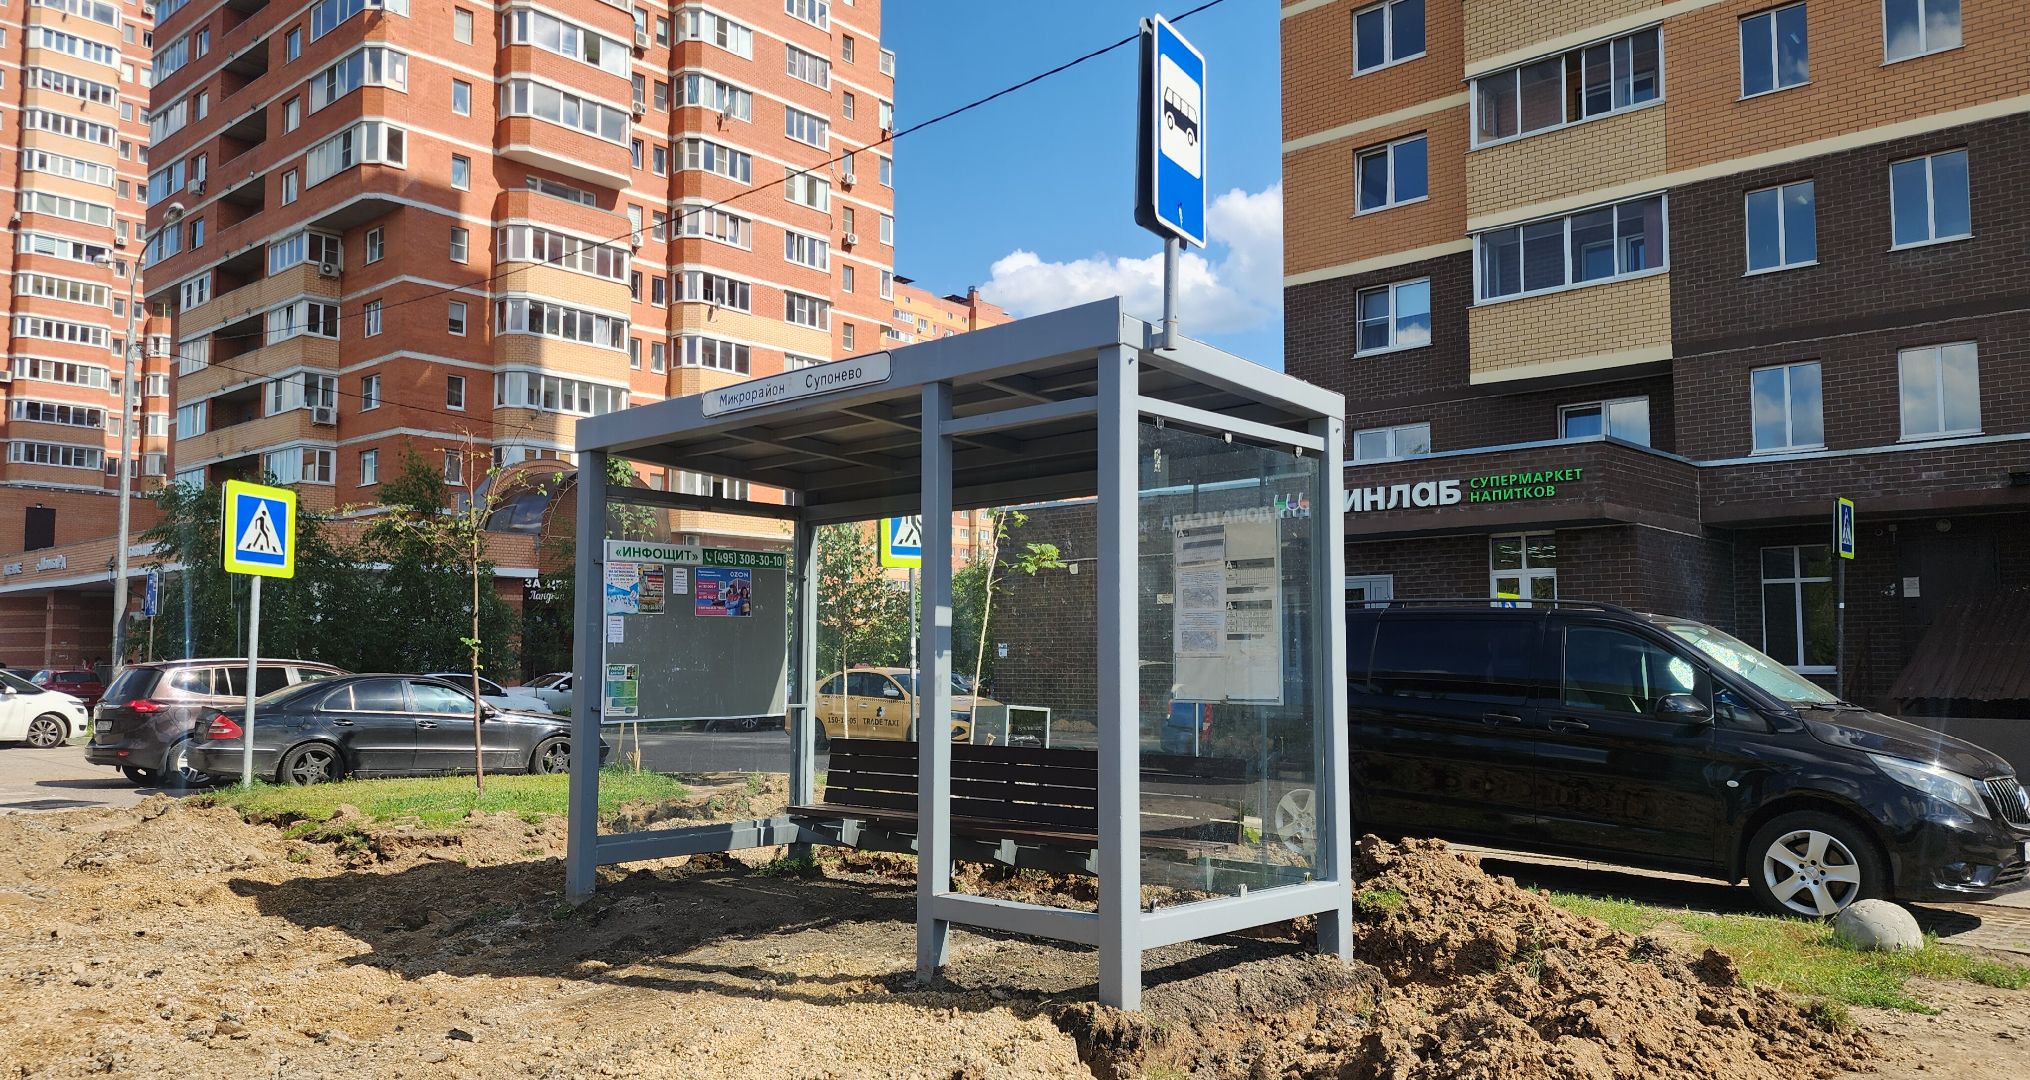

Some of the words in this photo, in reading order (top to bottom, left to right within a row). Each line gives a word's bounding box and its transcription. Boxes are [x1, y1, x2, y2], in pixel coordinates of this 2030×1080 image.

[719, 383, 785, 406] Микрорайон
[805, 367, 862, 390] Супонево
[1470, 468, 1583, 489] СУПЕРМАРКЕТ
[1470, 485, 1557, 502] НАПИТКОВ
[615, 546, 699, 561] «ИНФОЩИТ»
[714, 550, 737, 565] (495)
[739, 553, 783, 567] 308-30-10
[524, 578, 541, 588] ЗА
[884, 719, 899, 727] TAXI
